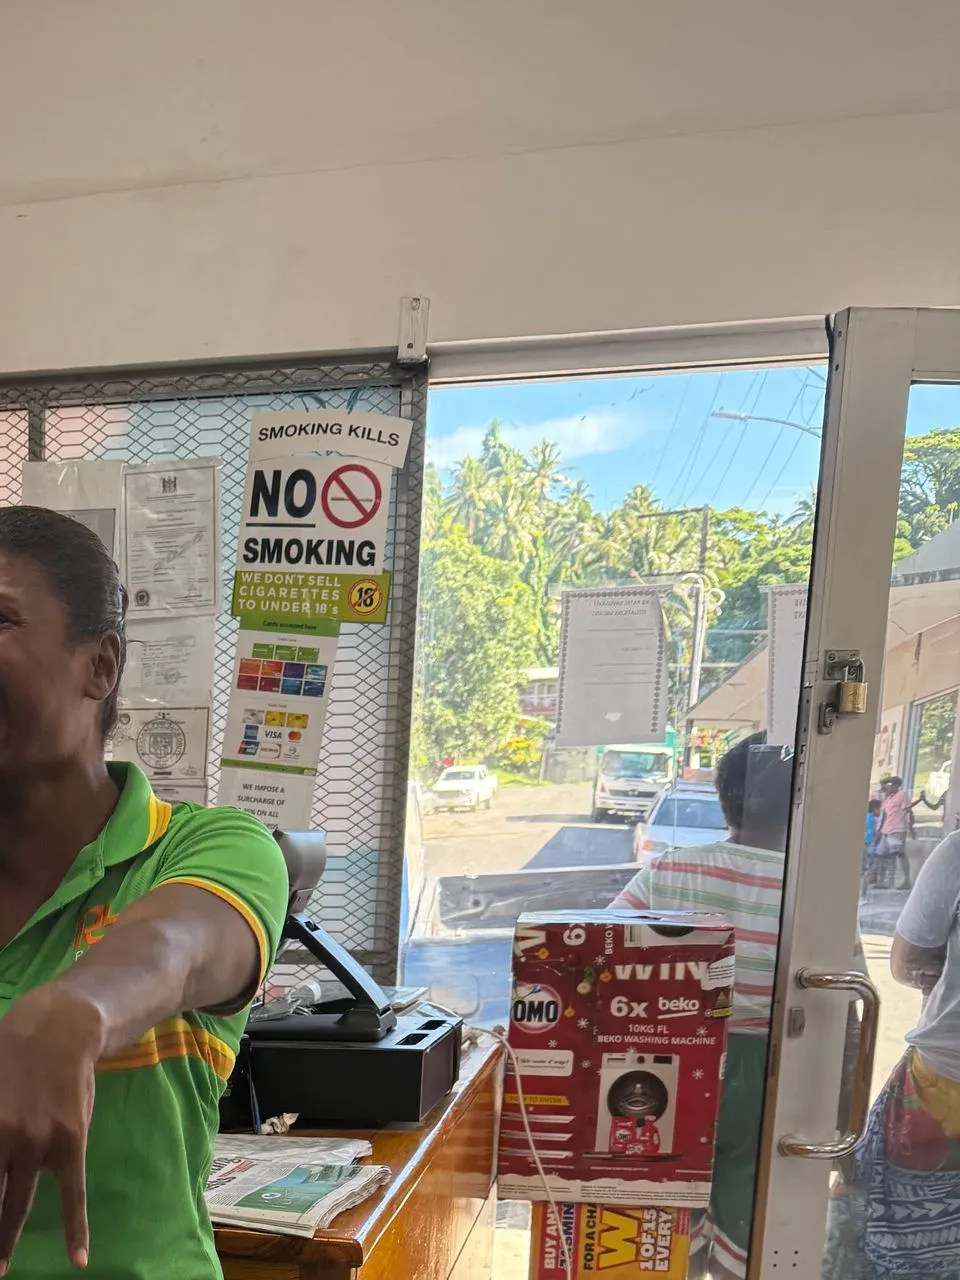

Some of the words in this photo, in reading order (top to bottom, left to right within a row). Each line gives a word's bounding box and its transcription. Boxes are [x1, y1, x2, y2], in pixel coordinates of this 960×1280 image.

[257, 422, 342, 442] SMOKING
[348, 423, 399, 447] KILLS
[249, 468, 317, 518] NO
[242, 537, 377, 567] SMOKING
[241, 571, 261, 583] WE
[264, 573, 304, 586] DON'T
[308, 575, 341, 588] SELL
[239, 586, 341, 601] CIGARETTES
[240, 599, 256, 610] TO
[260, 601, 310, 613] UNDER
[264, 730, 283, 739] VISA
[243, 783, 253, 791] WE
[254, 784, 279, 793] IMPOSE
[237, 795, 275, 805] SURCHARGE
[512, 999, 559, 1023] OMO
[610, 996, 648, 1019] 6x
[658, 996, 700, 1012] beko
[628, 1024, 654, 1034] 10KG
[657, 1025, 669, 1034] FL
[597, 1034, 622, 1044] BEKO
[624, 1035, 669, 1045] WASHING
[671, 1036, 716, 1046] MACHINE
[585, 1229, 596, 1242] A
[655, 1211, 673, 1272] EVERY
[544, 1239, 557, 1269] BUY
[584, 1241, 596, 1271] FOR
[641, 1234, 656, 1260] OF
